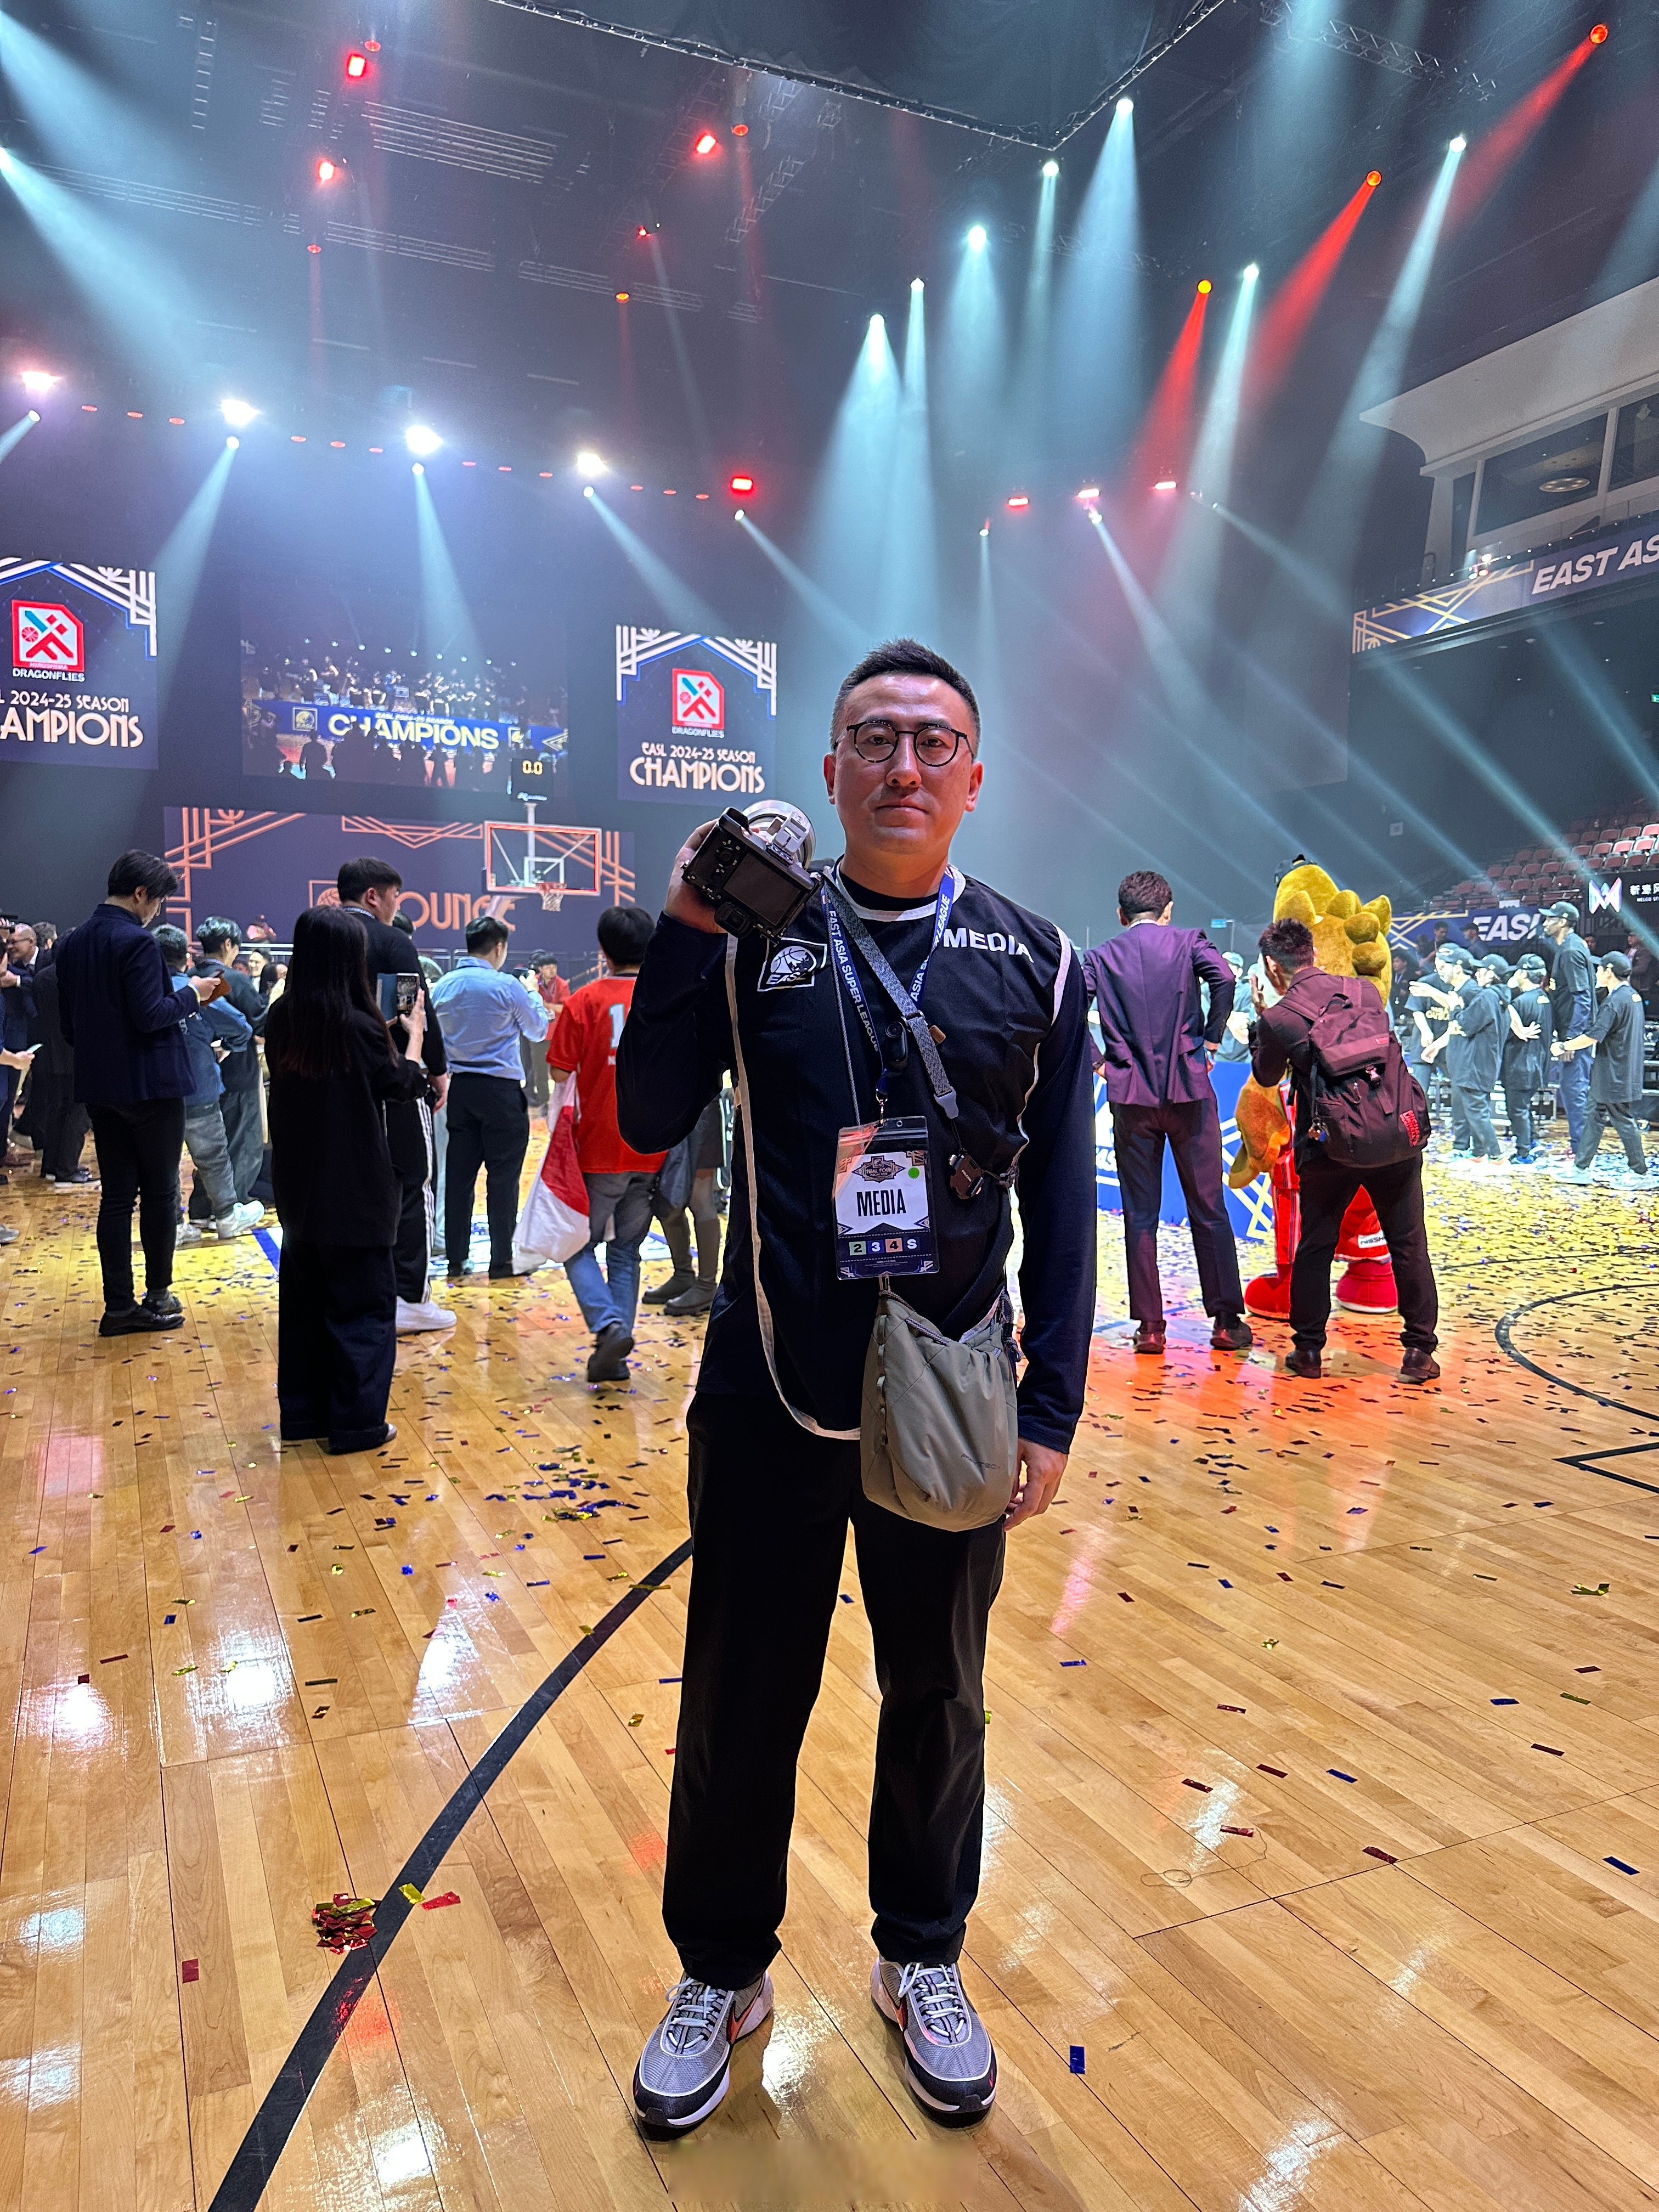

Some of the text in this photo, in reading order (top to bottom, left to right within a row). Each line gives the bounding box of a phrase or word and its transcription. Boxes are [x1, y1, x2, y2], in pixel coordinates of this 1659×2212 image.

[1532, 546, 1618, 595] EAST
[13, 668, 85, 682] DRAGONFLIES
[10, 690, 71, 708] 2024-25
[76, 695, 129, 713] SEASON
[641, 742, 755, 764] EASL 2024-25 SEASON
[630, 756, 765, 793] CHAMPIONS
[910, 972, 924, 1002] ASIA
[936, 894, 950, 939] LEAGUE
[943, 928, 1034, 963] MEDIA
[833, 939, 849, 964] ASIA
[842, 964, 861, 1003] SUPER
[856, 1005, 879, 1052] LEAGUE
[856, 1188, 906, 1217] MEDIA
[854, 1239, 917, 1253] 2 3 4 S
